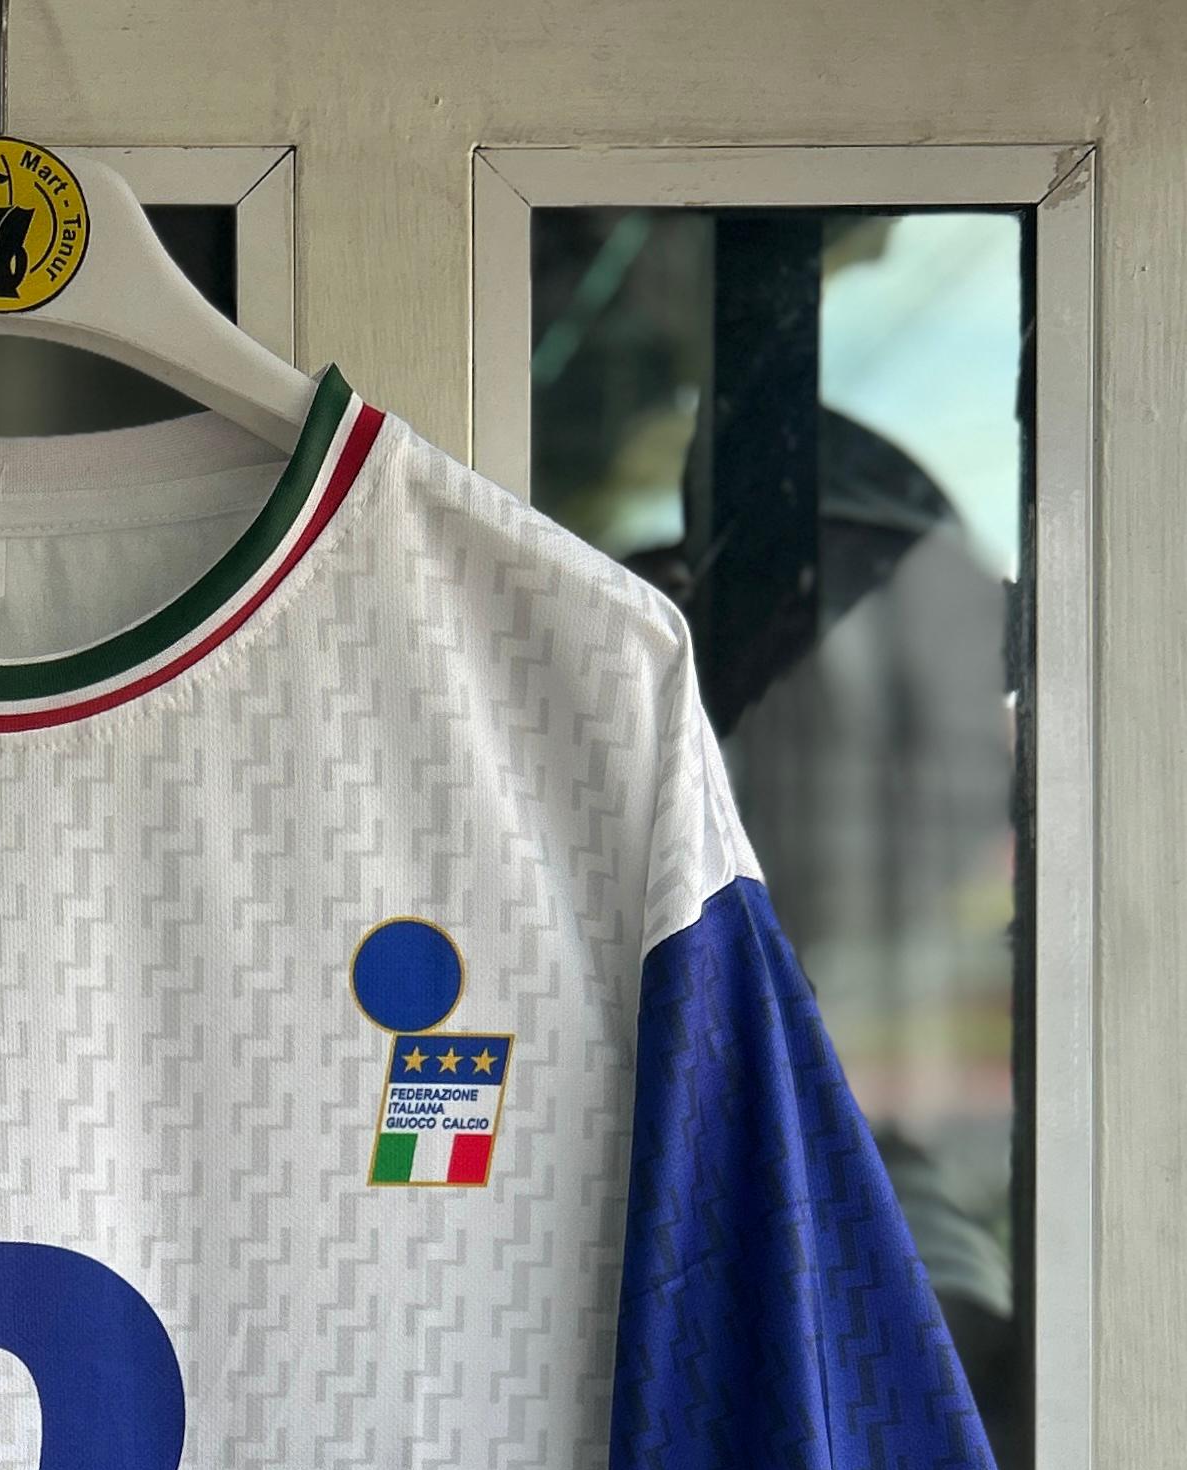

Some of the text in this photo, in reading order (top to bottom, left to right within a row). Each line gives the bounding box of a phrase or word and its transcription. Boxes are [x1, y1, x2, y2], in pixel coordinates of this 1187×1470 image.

[20, 150, 68, 195] Mart
[45, 213, 81, 282] Tanur
[390, 1088, 479, 1101] FEDERAZIONE
[388, 1102, 445, 1115] ITALIANA
[386, 1117, 489, 1130] GIUOCO CALCIO
